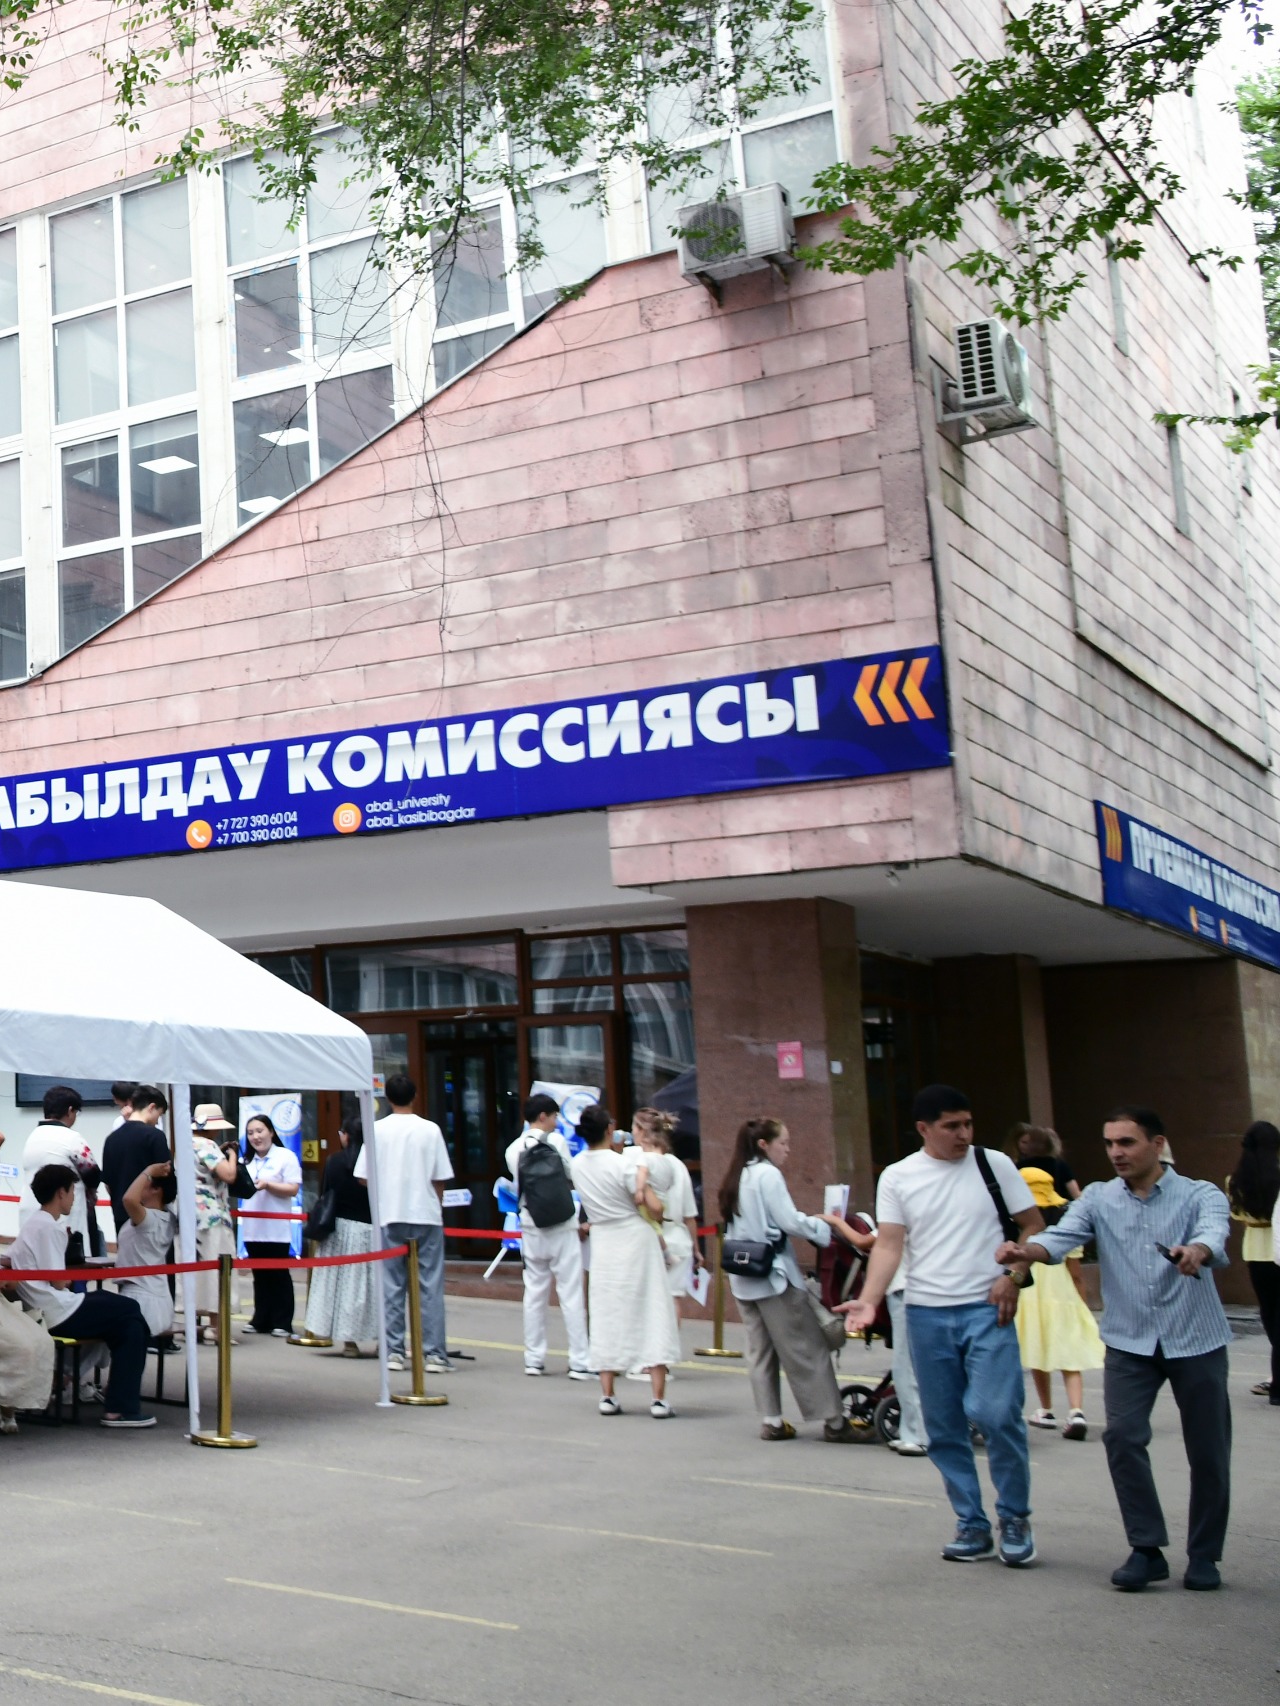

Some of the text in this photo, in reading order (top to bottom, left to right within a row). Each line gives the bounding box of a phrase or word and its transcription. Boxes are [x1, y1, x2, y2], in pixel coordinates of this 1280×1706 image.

[286, 674, 820, 795] КОМИССИЯСЫ
[365, 794, 451, 813] abai_university
[216, 811, 298, 831] +7 727 390 60 04
[365, 806, 477, 828] abai_kasibibagdar
[216, 825, 298, 845] +7 700 390 60 04
